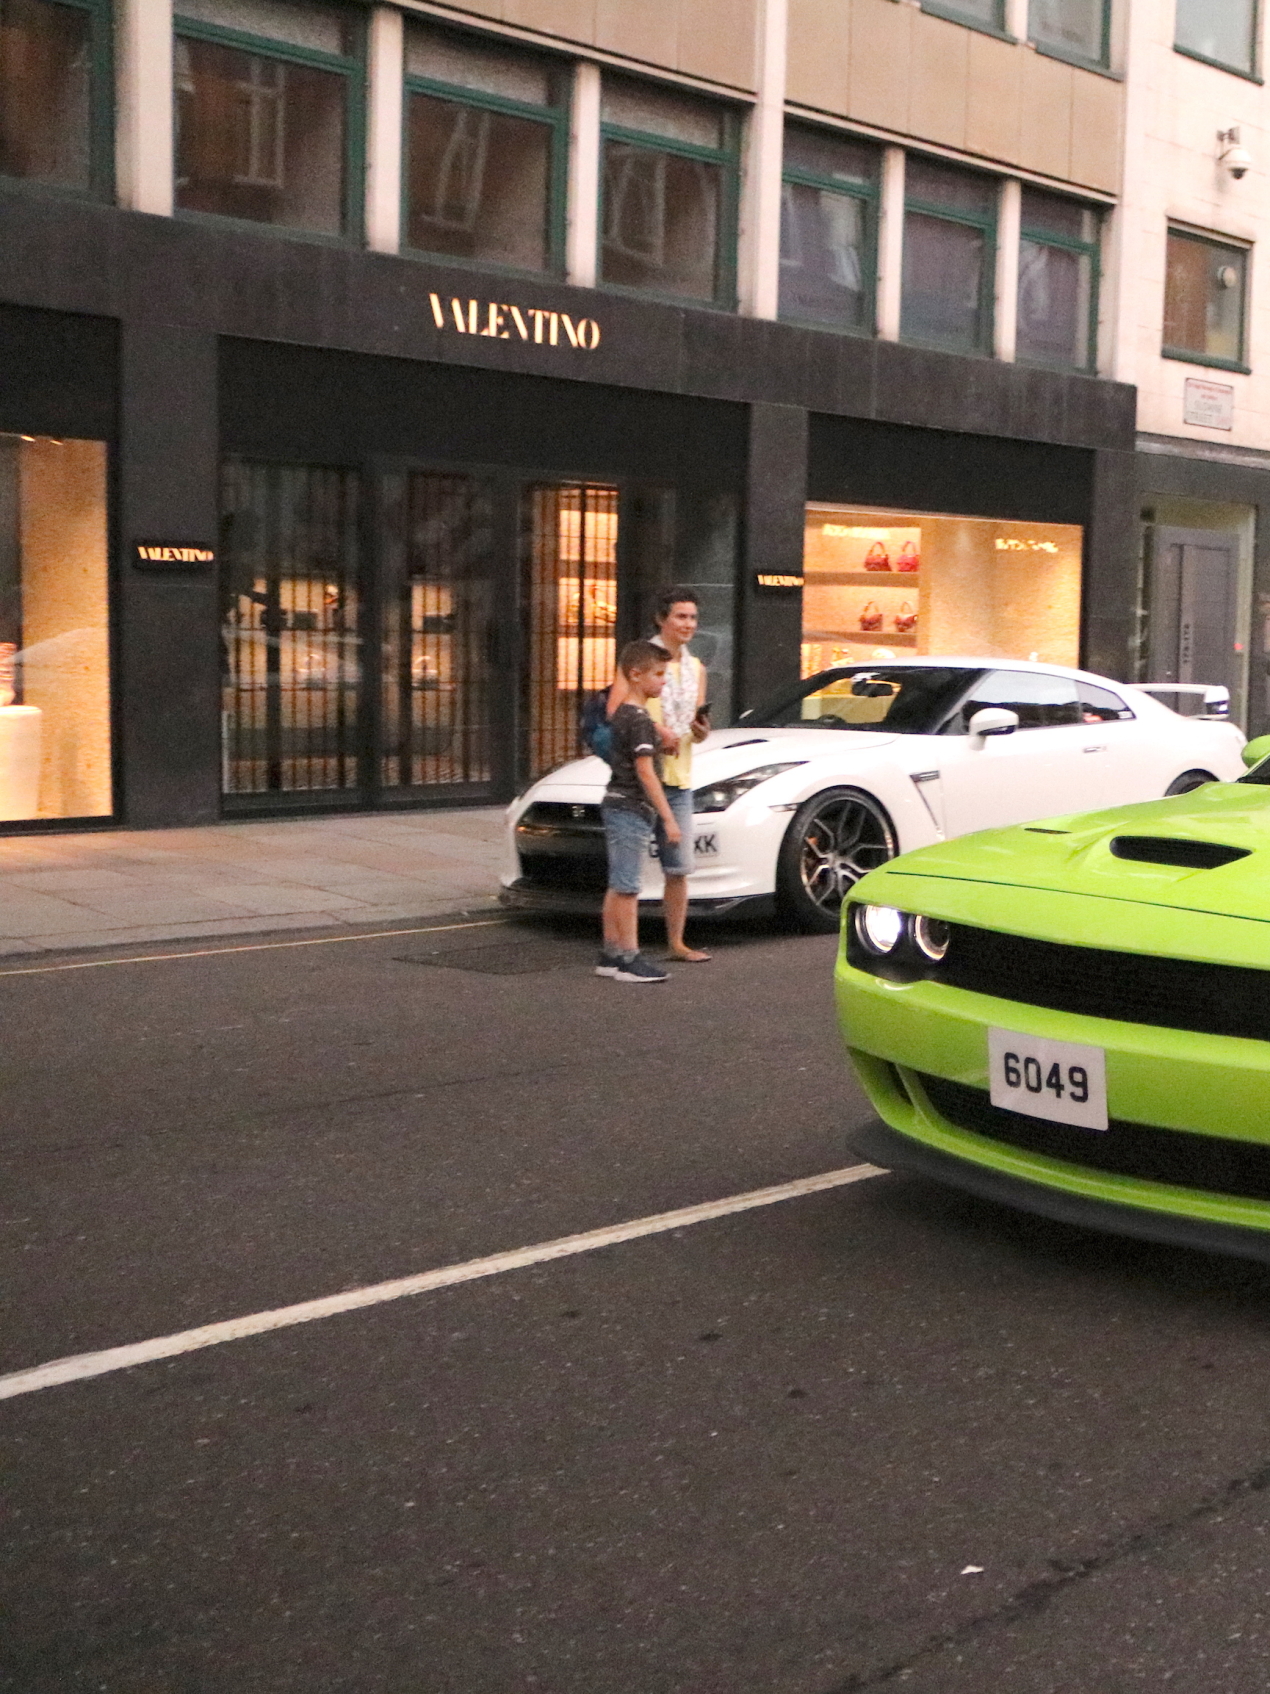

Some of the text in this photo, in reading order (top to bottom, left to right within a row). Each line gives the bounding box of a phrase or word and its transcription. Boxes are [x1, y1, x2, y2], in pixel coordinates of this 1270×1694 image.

[429, 293, 600, 350] VALENTINO
[138, 546, 214, 562] VALENTINO
[1004, 1051, 1089, 1104] 6049
